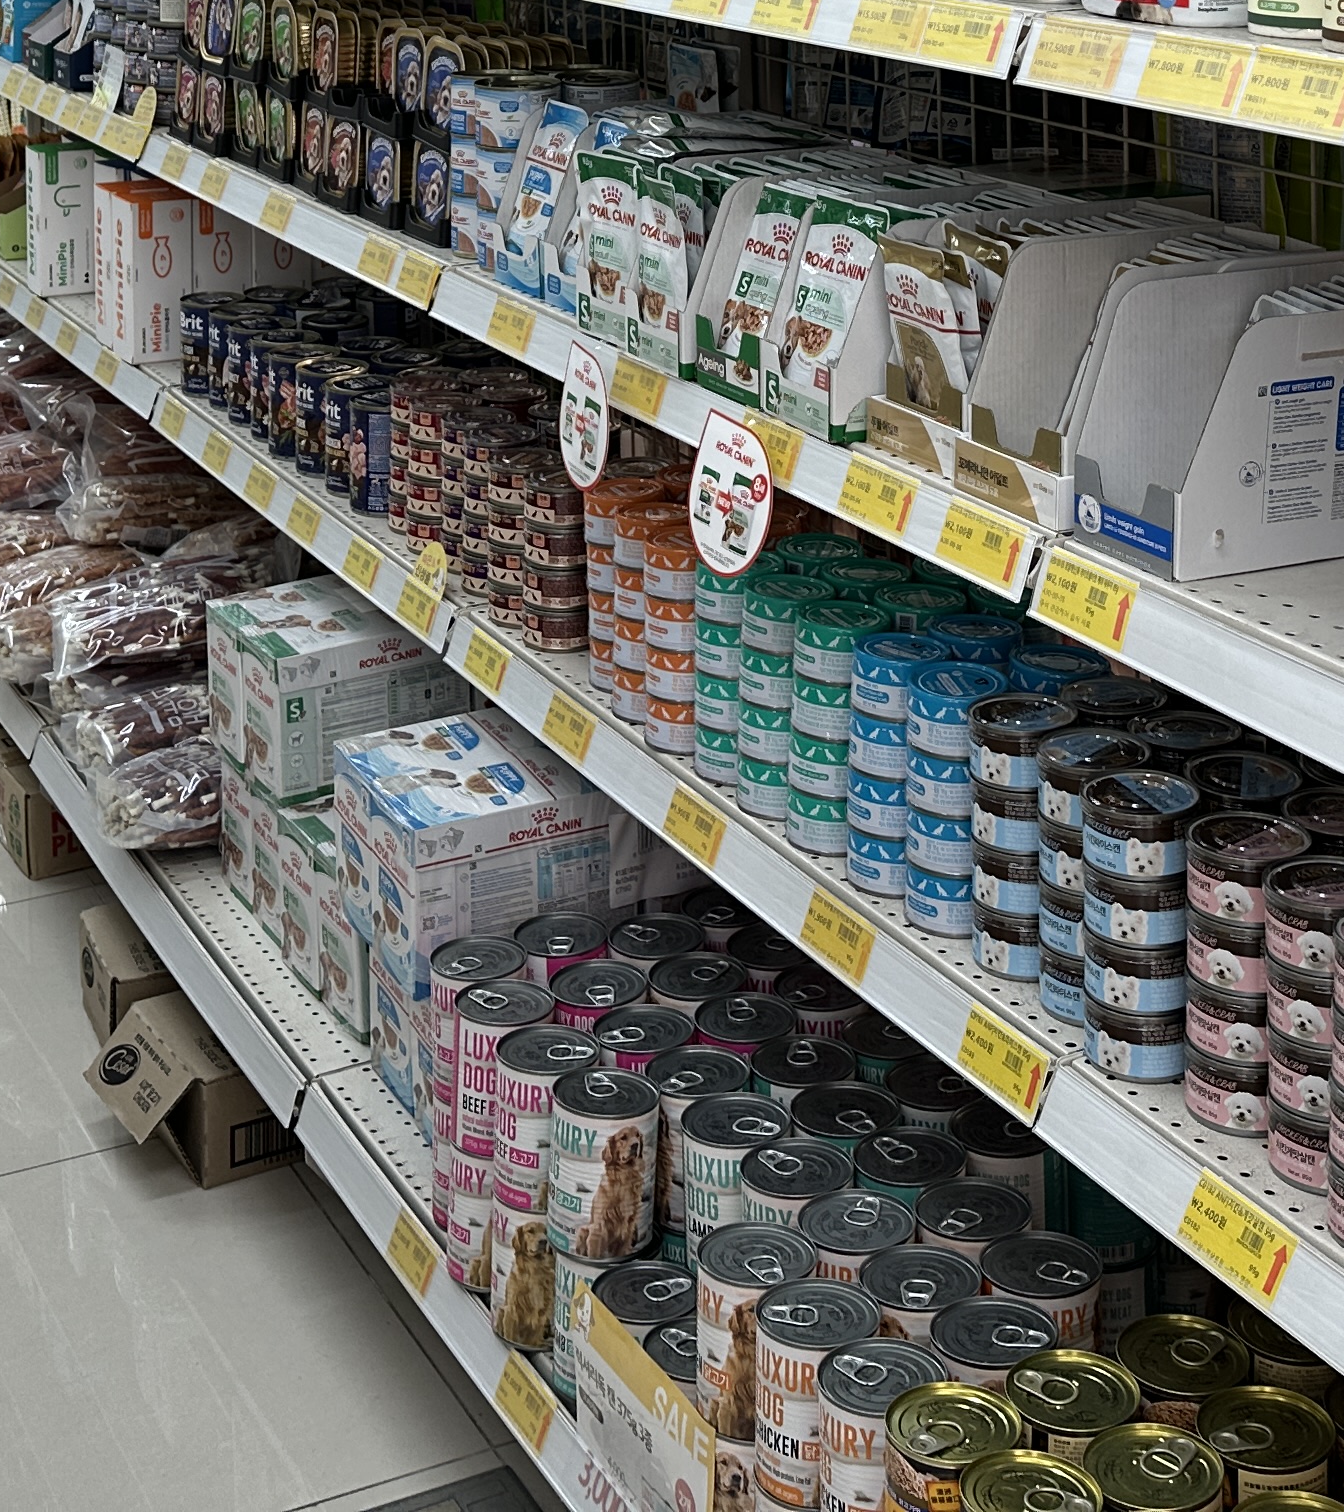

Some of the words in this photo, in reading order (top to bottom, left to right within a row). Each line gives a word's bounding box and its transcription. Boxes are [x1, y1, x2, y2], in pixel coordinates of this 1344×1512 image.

[744, 239, 774, 259] ROYAL
[805, 249, 836, 271] ROYAL
[836, 258, 868, 282] CANIN
[358, 653, 390, 670] ROYAL
[391, 647, 424, 664] CANIN
[509, 824, 545, 843] ROYAL
[547, 817, 582, 835] CANIN
[461, 1063, 496, 1094] DOG
[462, 1095, 488, 1118] BEEF
[652, 1386, 710, 1466] SALE
